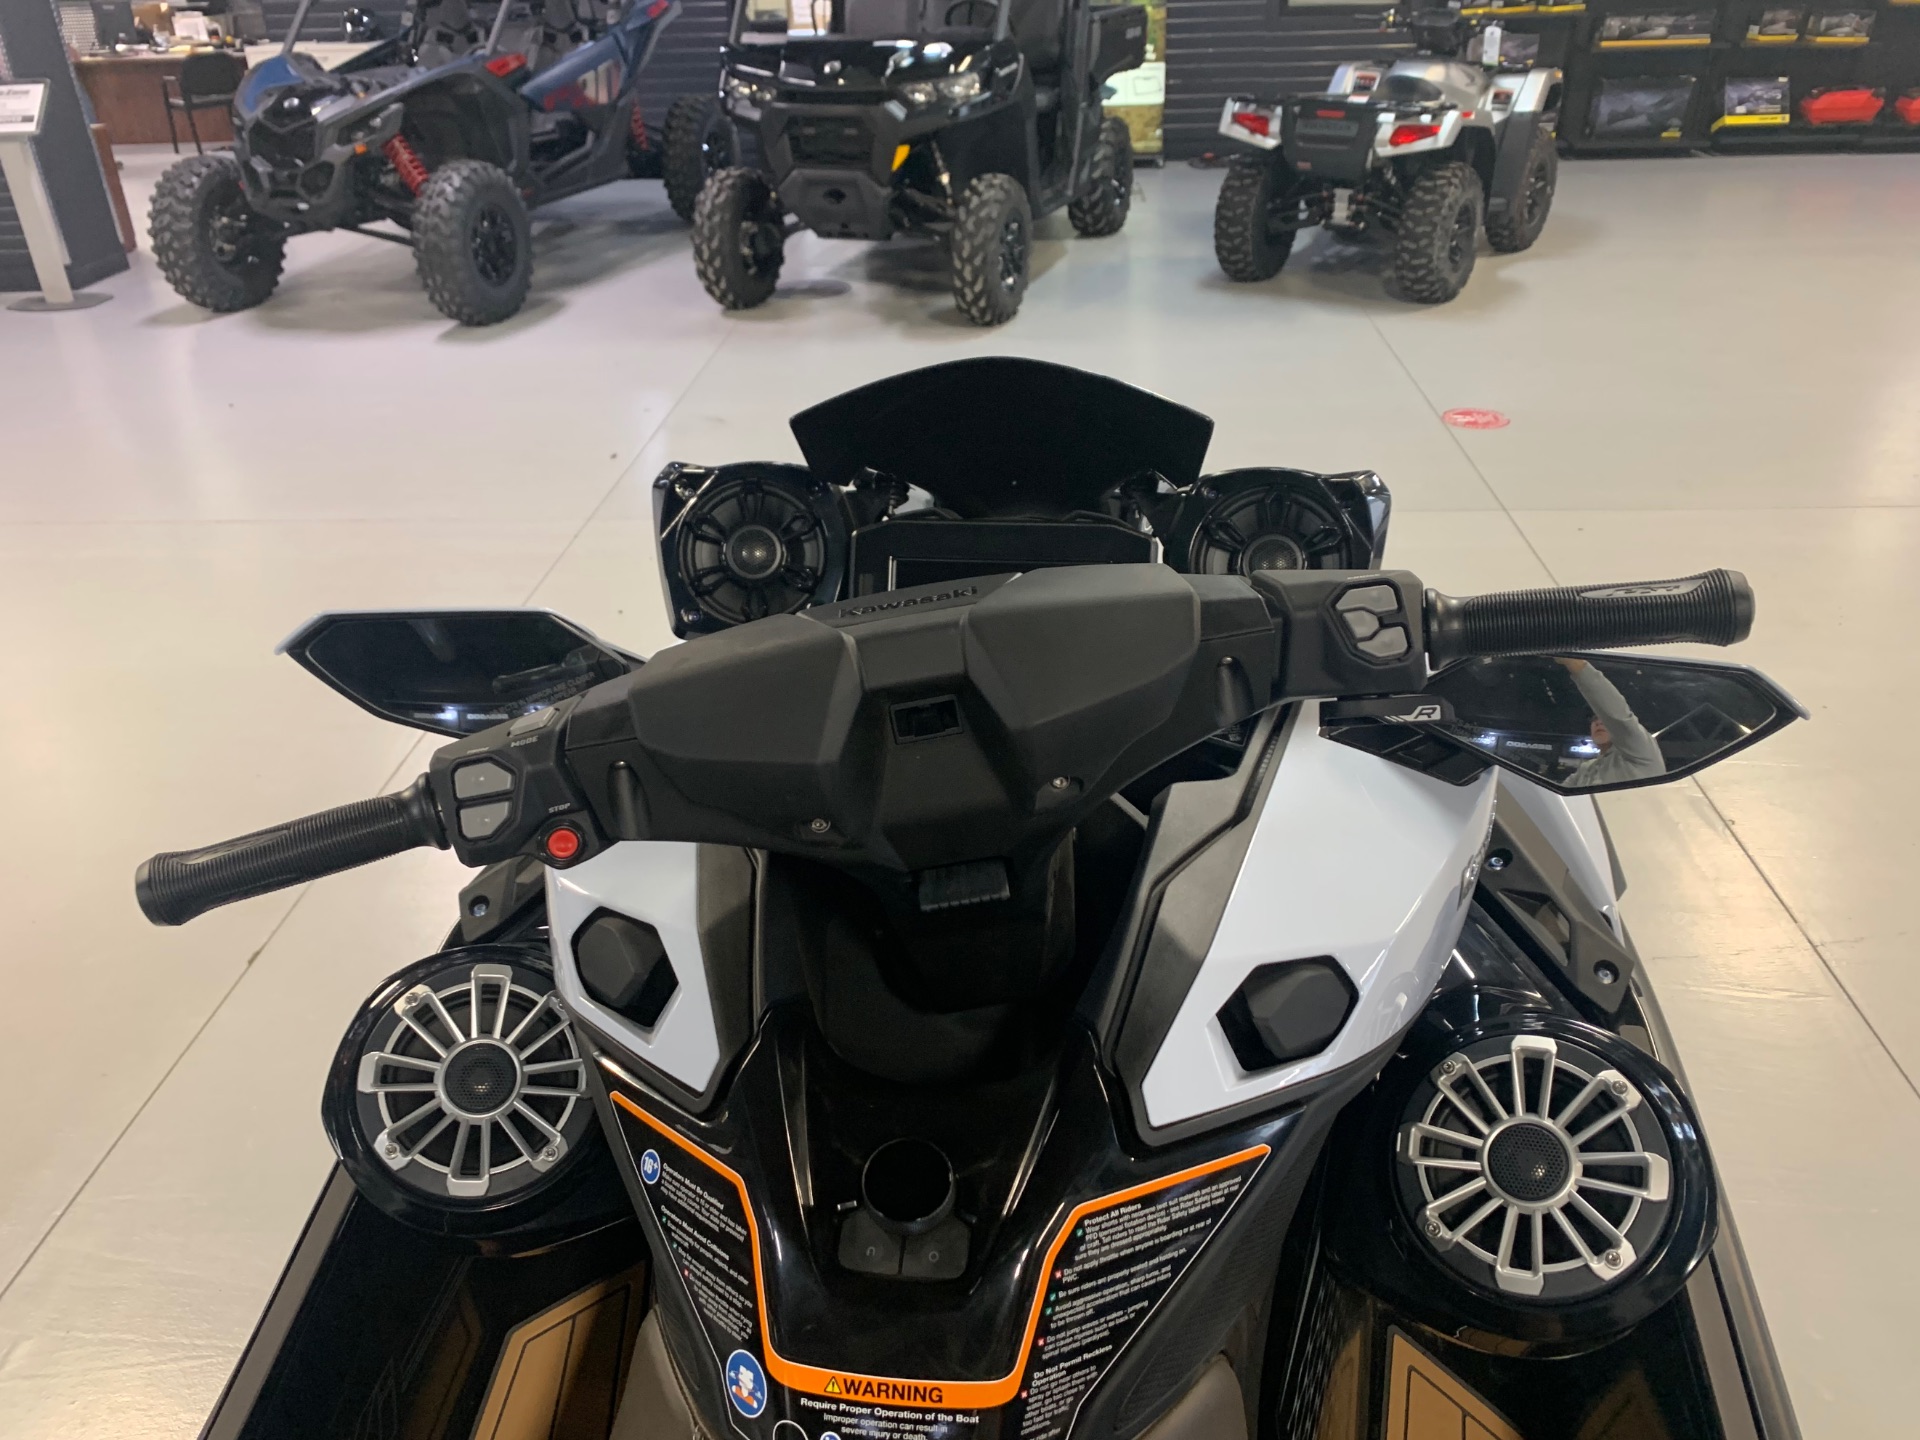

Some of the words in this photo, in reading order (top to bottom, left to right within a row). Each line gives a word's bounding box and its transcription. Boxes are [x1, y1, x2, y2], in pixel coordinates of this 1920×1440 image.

[839, 586, 977, 618] Kawasaki
[511, 736, 539, 747] MODE
[549, 803, 571, 813] STOP
[644, 1157, 658, 1174] 16+
[1085, 1213, 1109, 1226] Protect
[1111, 1210, 1119, 1218] All
[1121, 1204, 1141, 1215] Riders
[1063, 1272, 1079, 1283] PWC.
[1046, 1364, 1058, 1374] Not
[1060, 1356, 1081, 1369] Permit
[1084, 1345, 1113, 1361] Reckless
[1032, 1370, 1066, 1387] Operation
[843, 1378, 943, 1403] WARNING
[801, 1398, 837, 1411] Require
[839, 1404, 872, 1416] Proper
[874, 1408, 919, 1420] Operation
[921, 1412, 931, 1421] of
[933, 1412, 953, 1422] the
[956, 1414, 979, 1424] Boat
[823, 1413, 859, 1426] Improper
[860, 1419, 902, 1430] operation
[915, 1424, 937, 1433] result
[841, 1427, 866, 1436] severe
[869, 1429, 891, 1440] injury
[903, 1432, 928, 1440] death.
